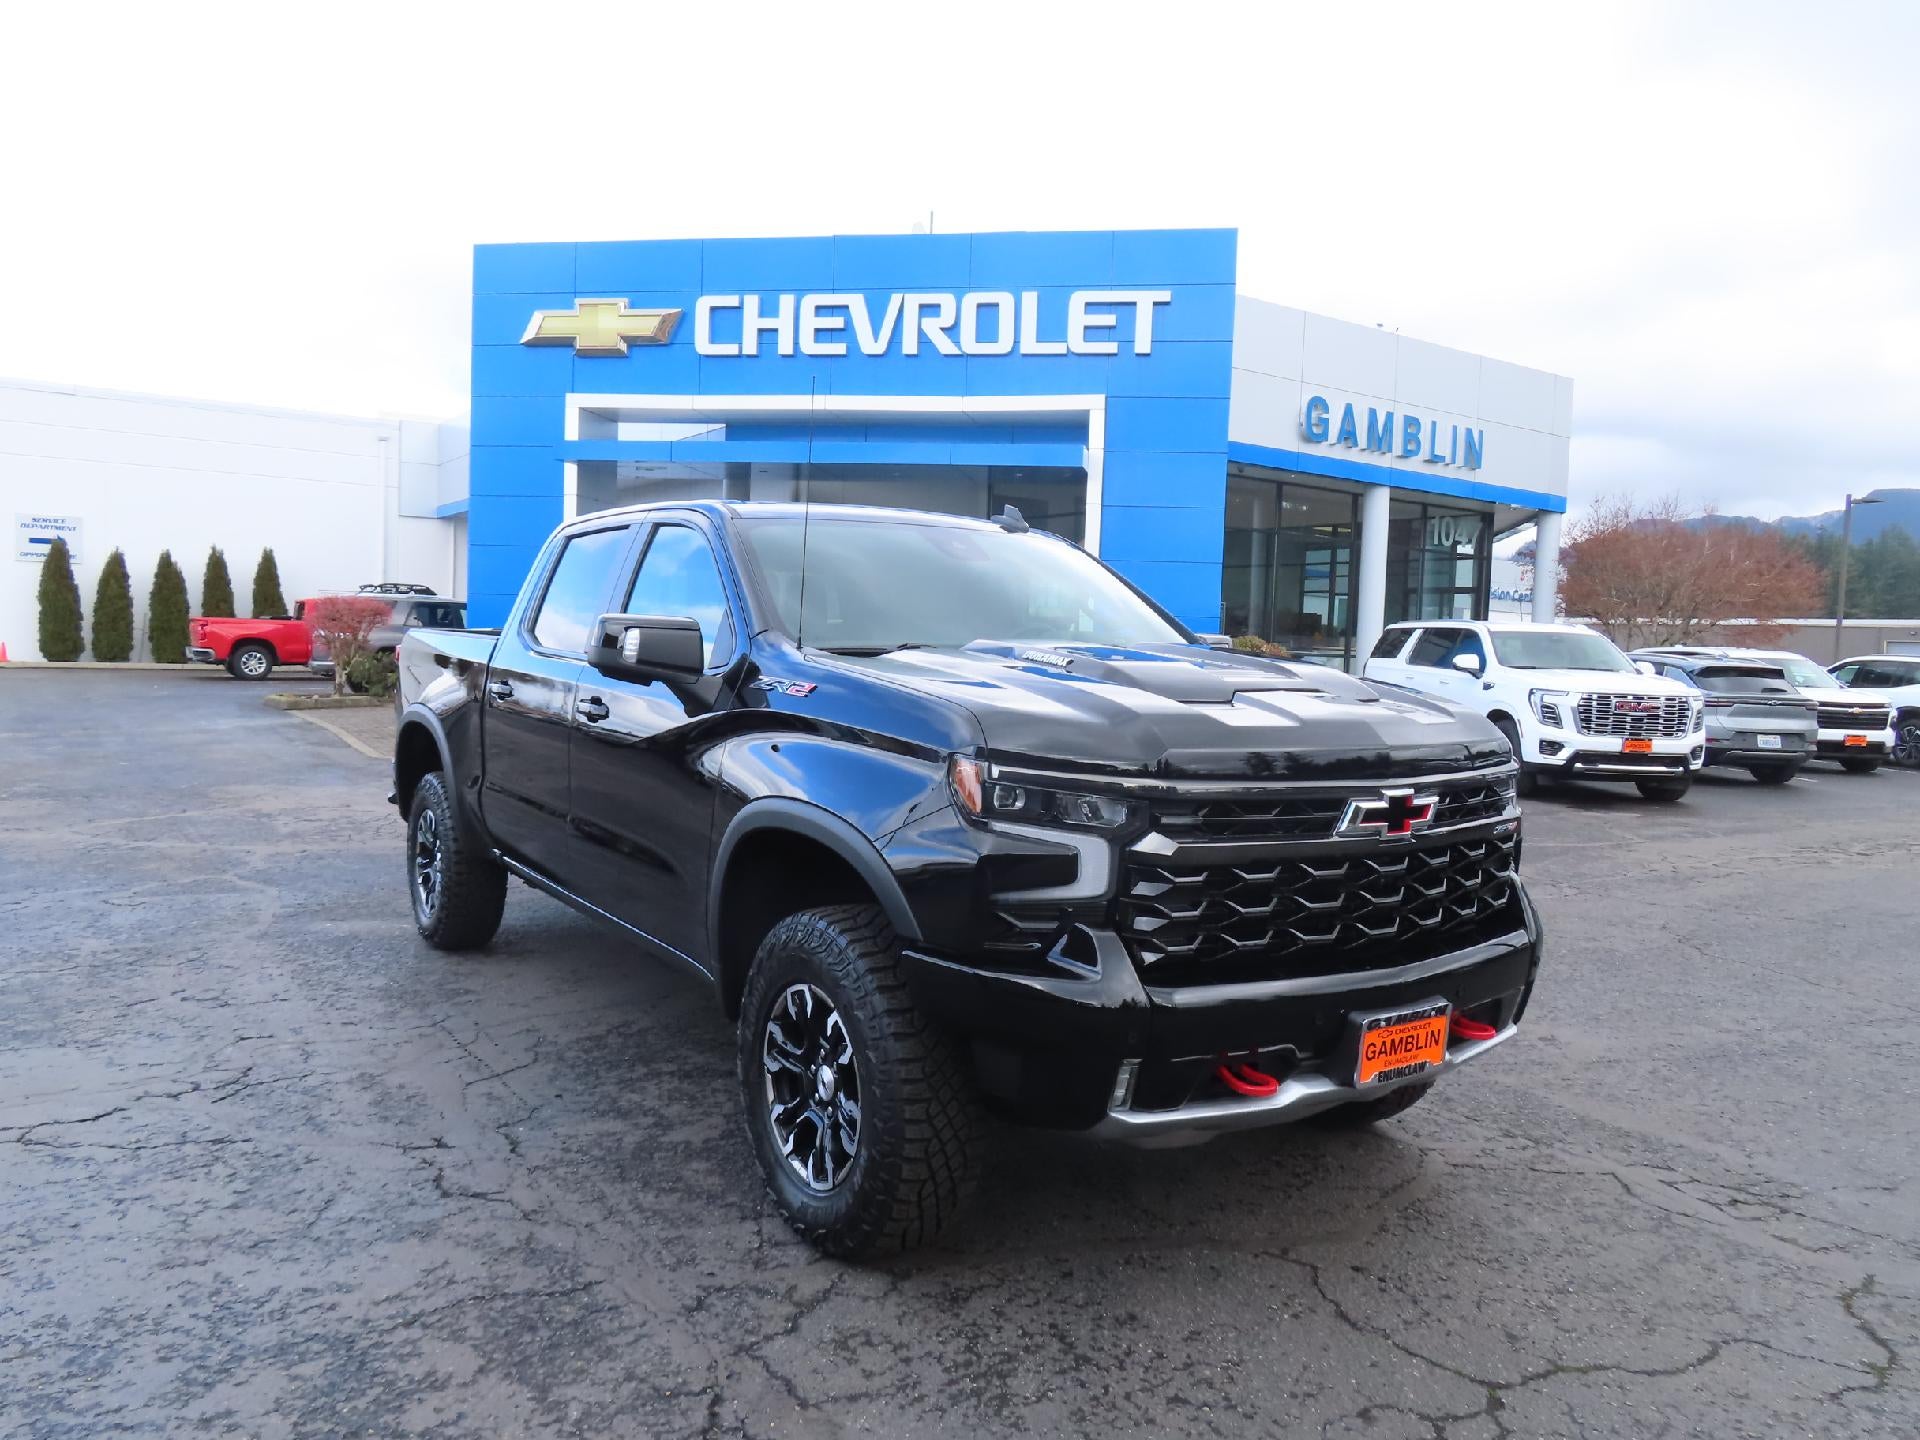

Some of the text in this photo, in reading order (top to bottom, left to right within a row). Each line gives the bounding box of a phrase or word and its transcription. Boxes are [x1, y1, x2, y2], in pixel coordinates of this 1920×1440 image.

[694, 290, 1172, 356] CHEVROLET
[1304, 395, 1484, 470] GAMBLIN
[1021, 650, 1074, 668] DURAMAX
[749, 676, 818, 697] ZR2
[1615, 700, 1660, 713] GMC
[1395, 1022, 1432, 1036] CHEVROLET
[1365, 1029, 1441, 1062] GAMBLIN
[1378, 1060, 1428, 1083] ENUMCLAW
